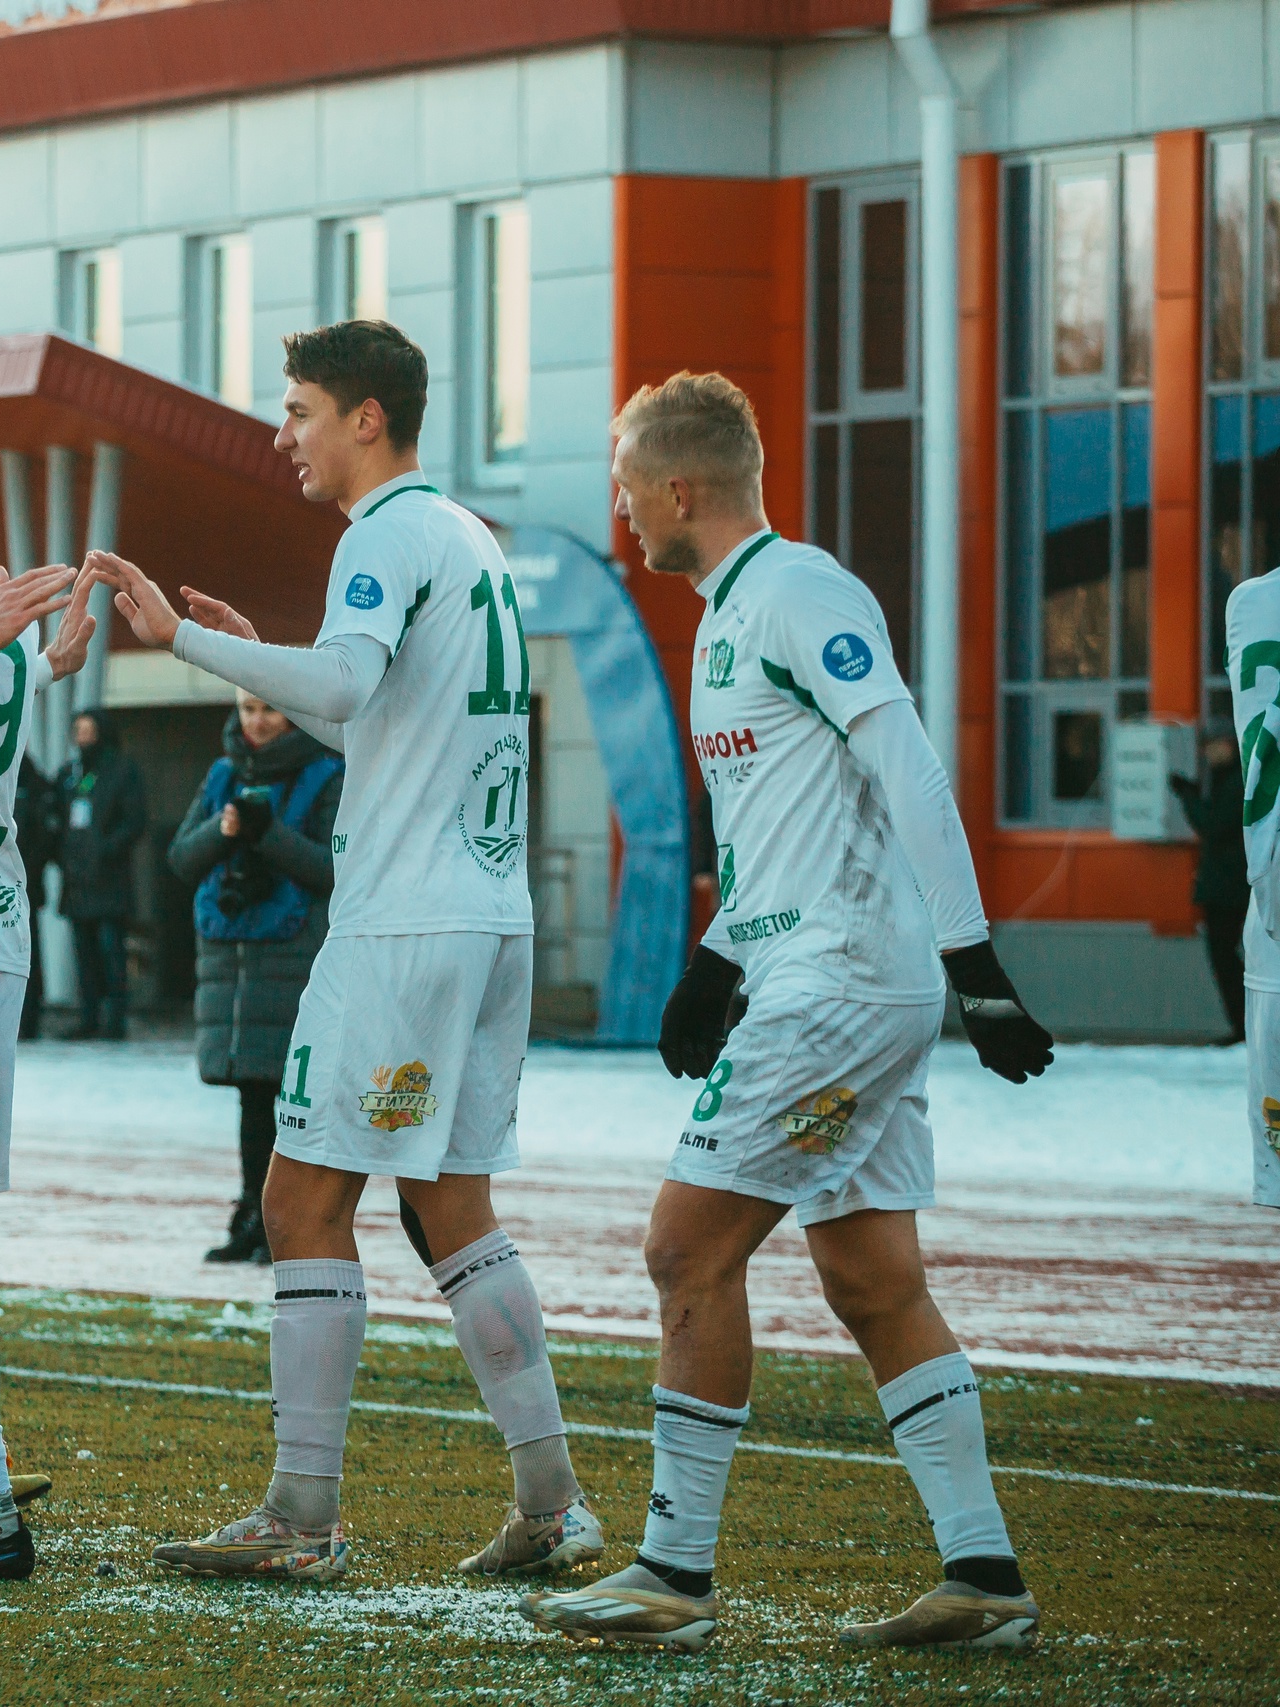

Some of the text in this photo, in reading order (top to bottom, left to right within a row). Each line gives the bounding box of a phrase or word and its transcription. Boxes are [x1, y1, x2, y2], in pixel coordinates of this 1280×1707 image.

[468, 569, 531, 716] 11
[373, 1095, 428, 1109] ТИТУЛ
[692, 1058, 733, 1122] 8
